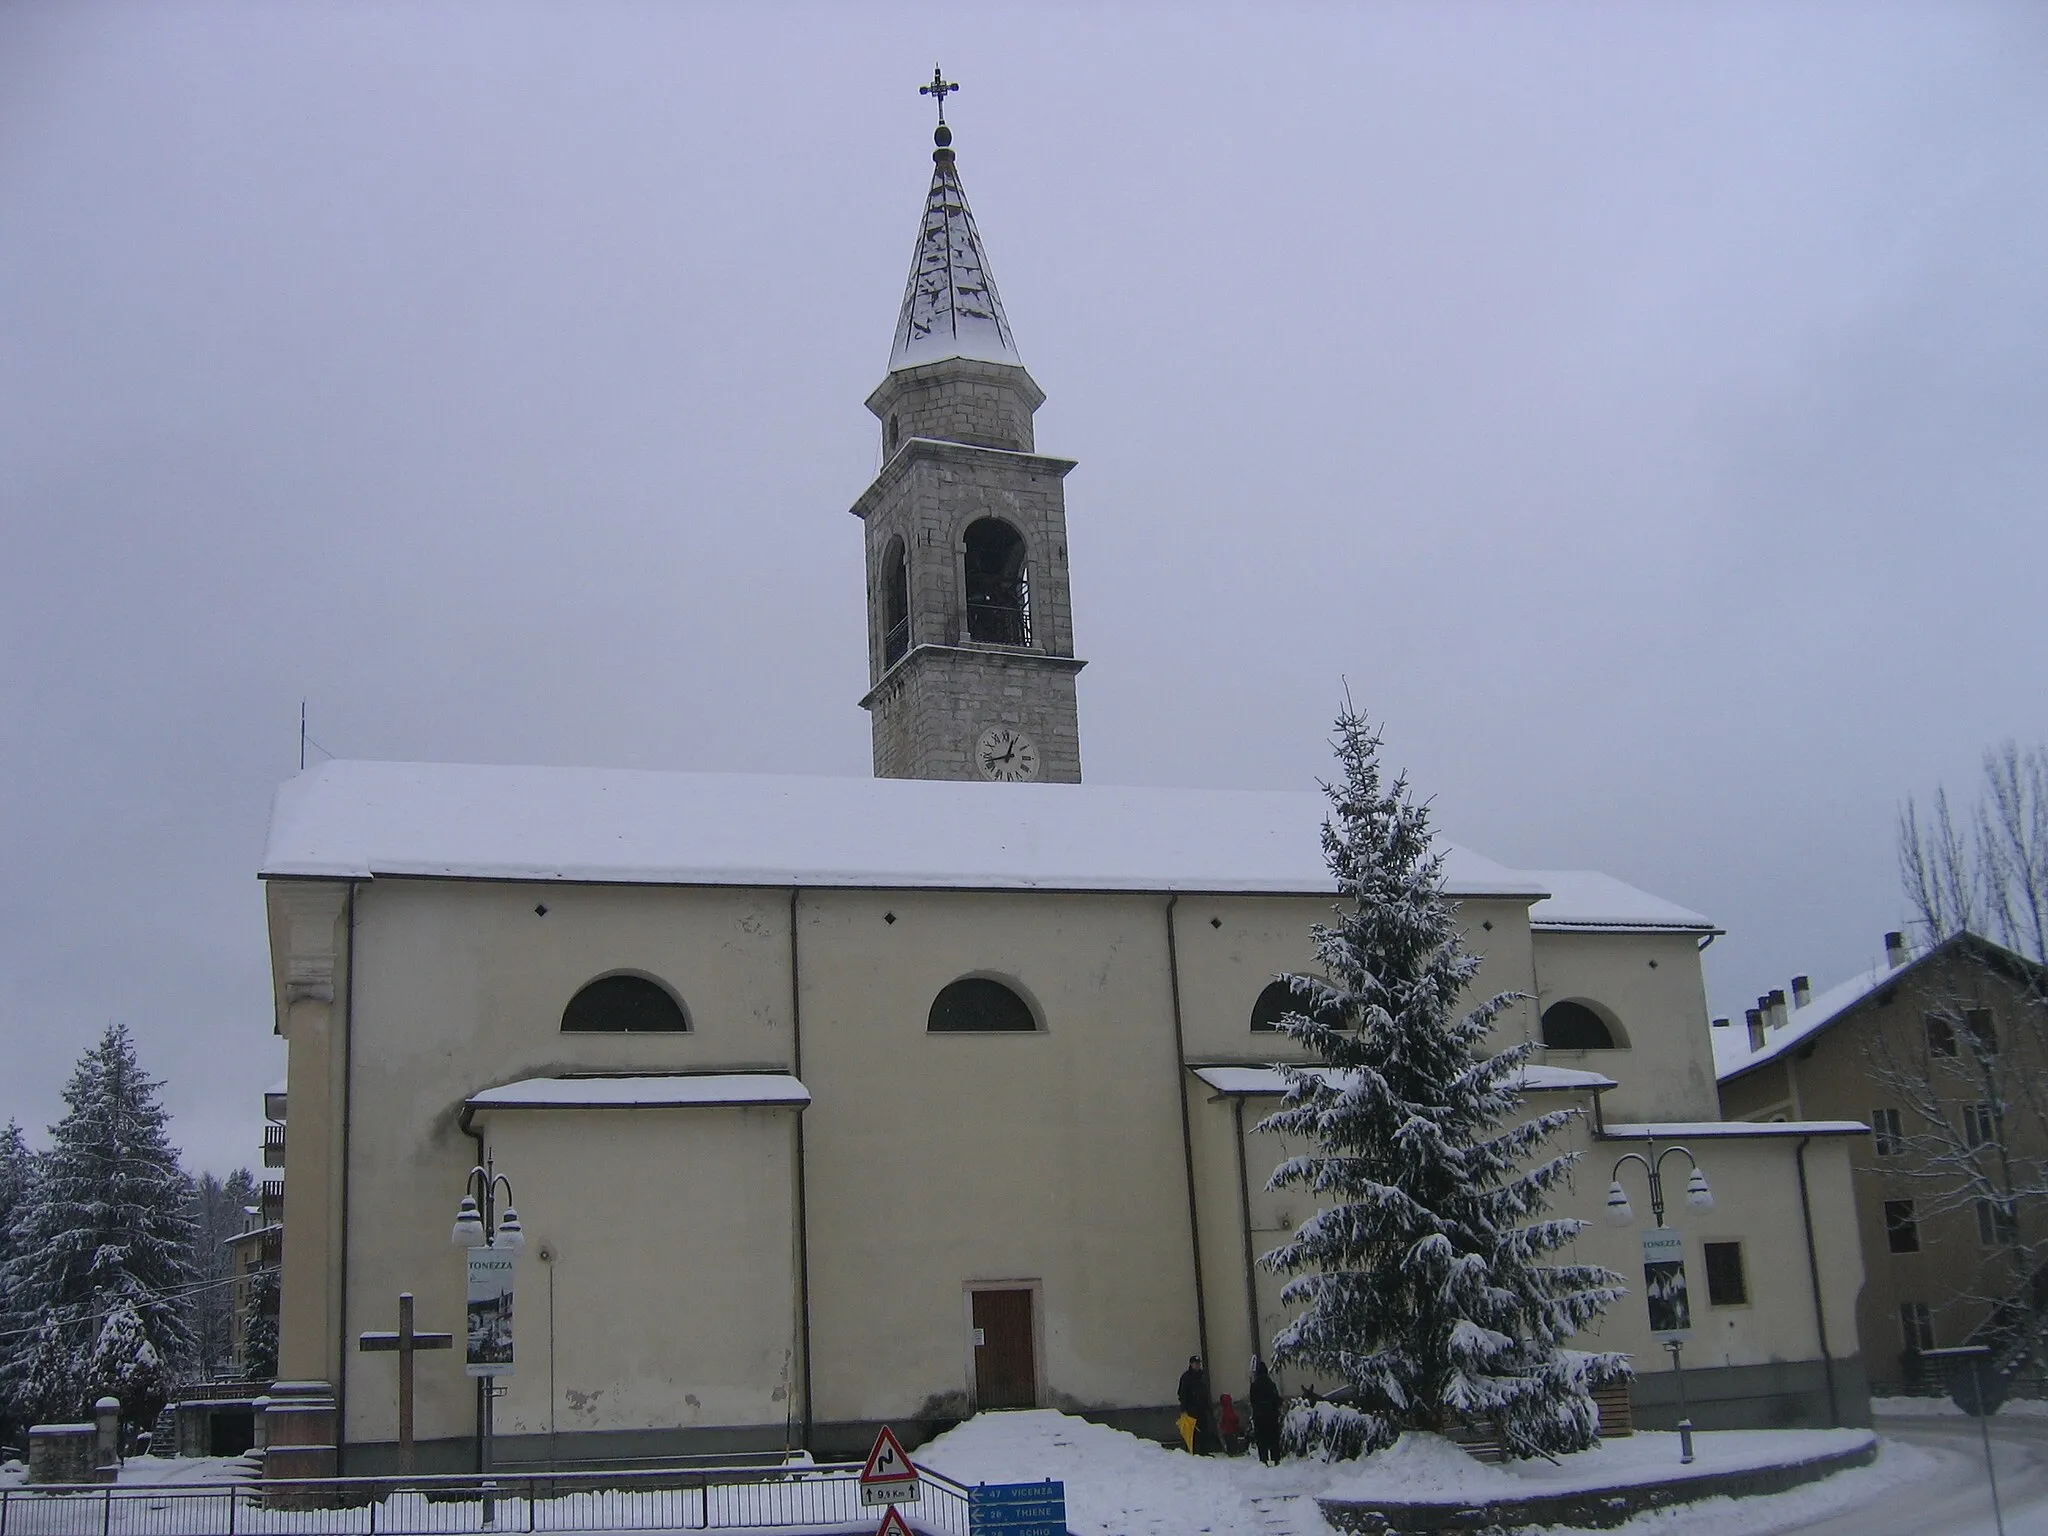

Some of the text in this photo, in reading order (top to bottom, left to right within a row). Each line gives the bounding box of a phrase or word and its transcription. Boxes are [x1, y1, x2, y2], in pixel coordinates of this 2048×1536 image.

[1643, 1240, 1682, 1248] TONEZZA
[470, 1261, 512, 1270] TONEZZA
[892, 1490, 904, 1498] Km
[990, 1487, 1053, 1498] 47 VICENZA
[1015, 1508, 1051, 1517] THIENE
[1019, 1528, 1050, 1536] SCHIO
